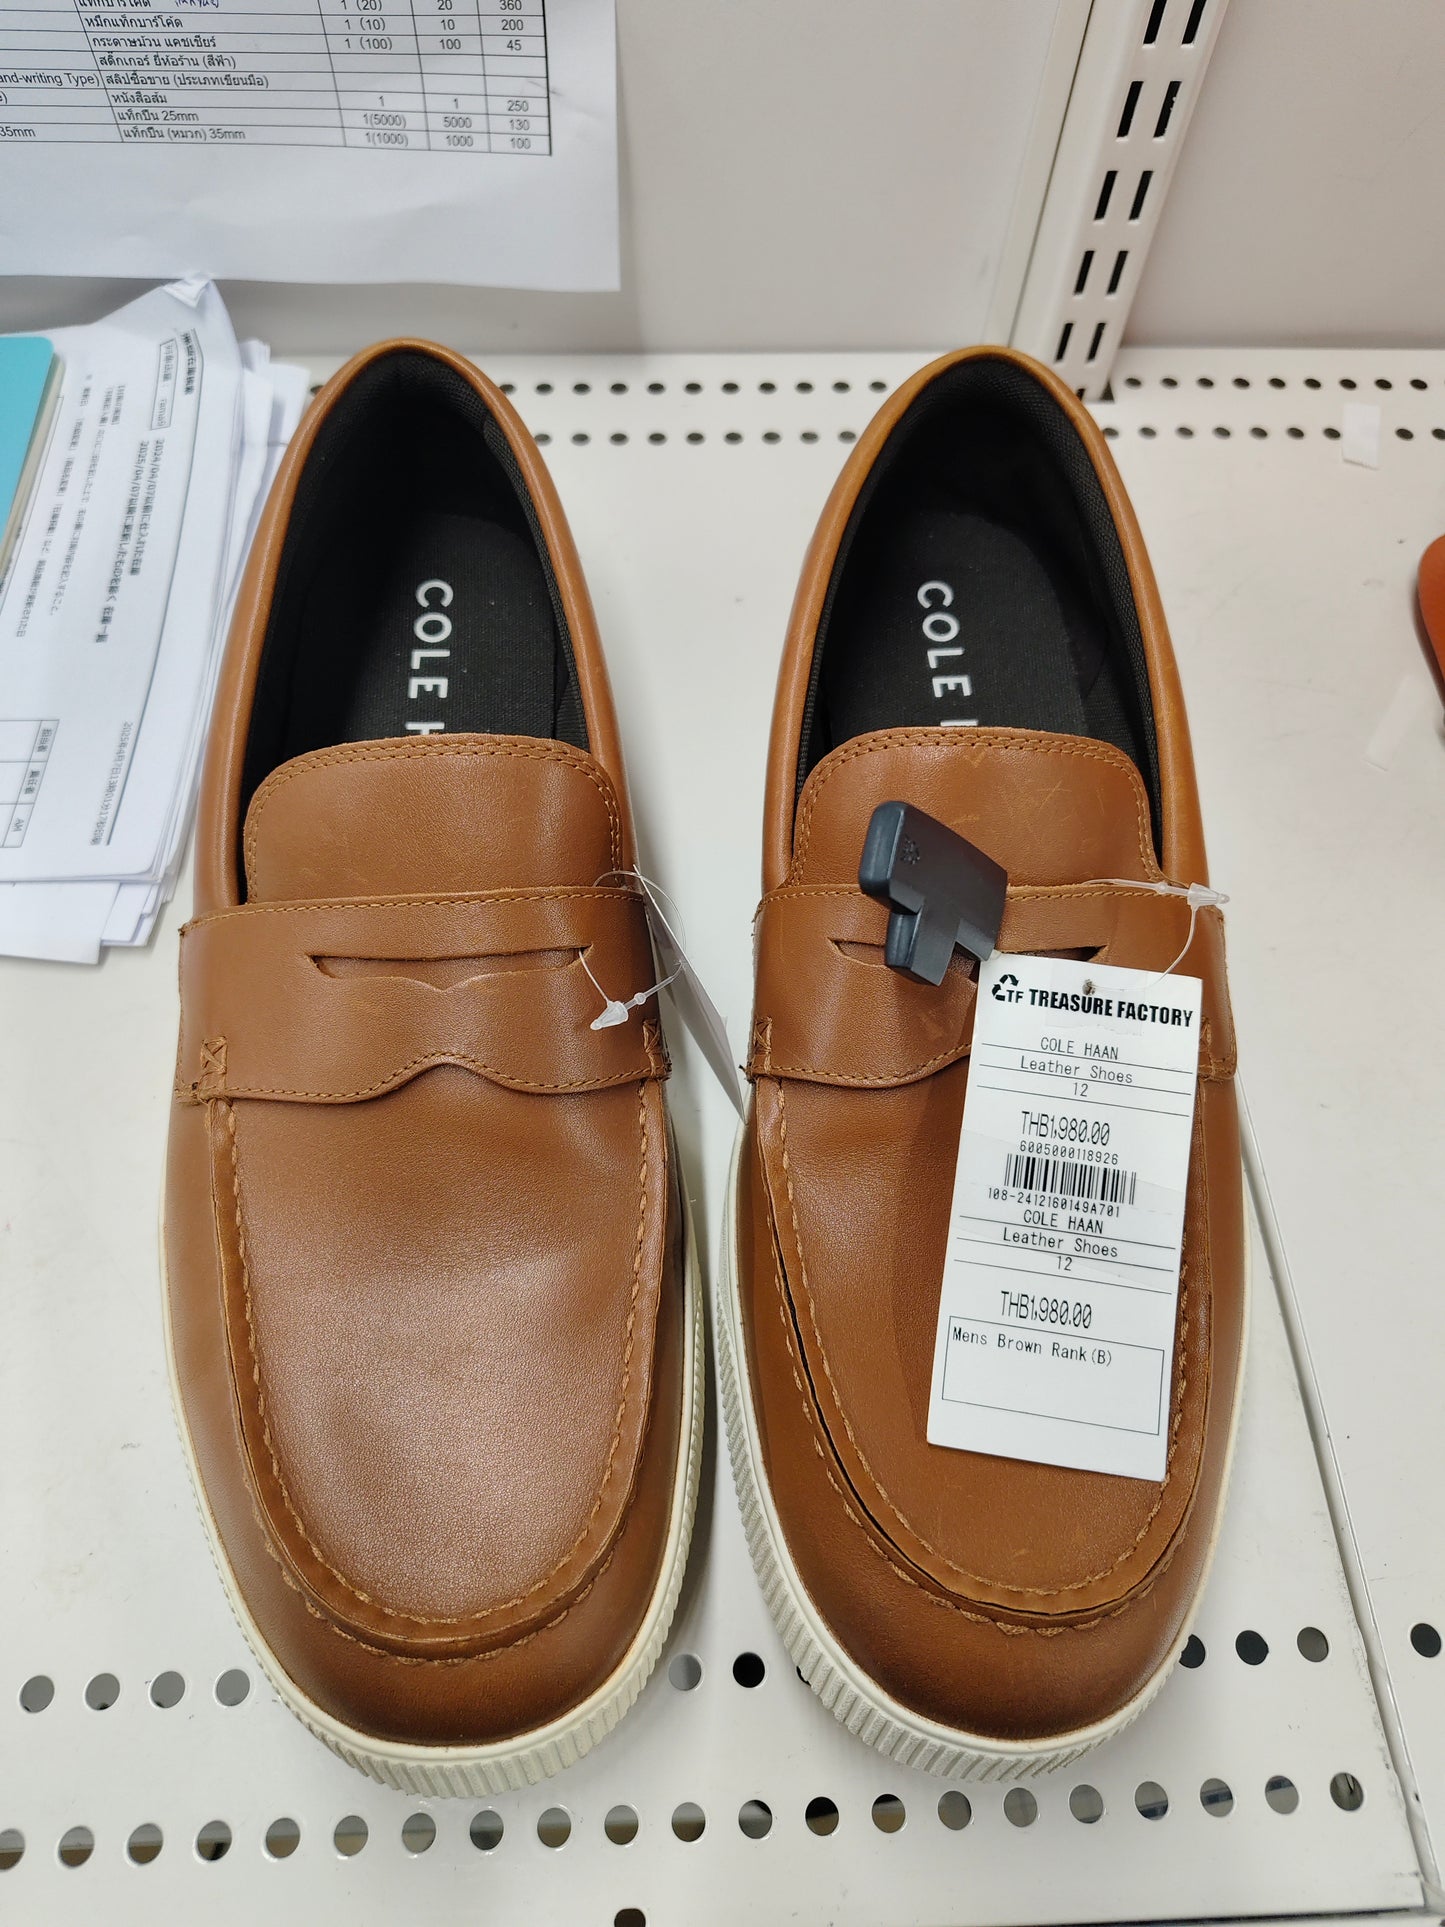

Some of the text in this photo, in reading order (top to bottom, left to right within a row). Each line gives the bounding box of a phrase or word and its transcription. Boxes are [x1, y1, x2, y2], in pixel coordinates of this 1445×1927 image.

[357, 0, 383, 11] (20)
[438, 0, 453, 10] 20
[499, 0, 522, 11] 360
[360, 17, 386, 31] (10)
[441, 20, 455, 31] 10
[501, 20, 524, 31] 200
[359, 36, 393, 50] (100)
[439, 38, 461, 50] 100
[506, 39, 522, 51] 45
[64, 72, 99, 87] Type)
[507, 100, 529, 112] 250
[161, 110, 199, 121] 25mm
[363, 113, 407, 128] 1(5000)
[443, 116, 472, 129] 5000
[509, 118, 530, 131] 130
[209, 128, 246, 139] 35mm
[365, 132, 409, 147] 1(1000)
[445, 135, 473, 147] 1000
[510, 137, 531, 149] 100
[408, 578, 454, 699] COLE
[917, 580, 973, 698] COLE
[1029, 988, 1114, 1017] TREASURE
[1117, 1001, 1194, 1028] FACTORY
[1040, 1037, 1119, 1060] COLE HAAN
[1020, 1055, 1133, 1084] Leather Shoes
[1073, 1082, 1089, 1097] 12
[1021, 1110, 1111, 1146] THB1,980.00
[1020, 1140, 1119, 1165] 6005000118926
[988, 1187, 1121, 1217] 108-2412160149A701
[1023, 1209, 1104, 1234] COLE HAAN
[1003, 1227, 1119, 1258] Leather Shoes
[1056, 1256, 1073, 1271] 12
[1000, 1290, 1093, 1329] THB1,980.00
[952, 1326, 1112, 1367] Mens Brown Rank(B)
